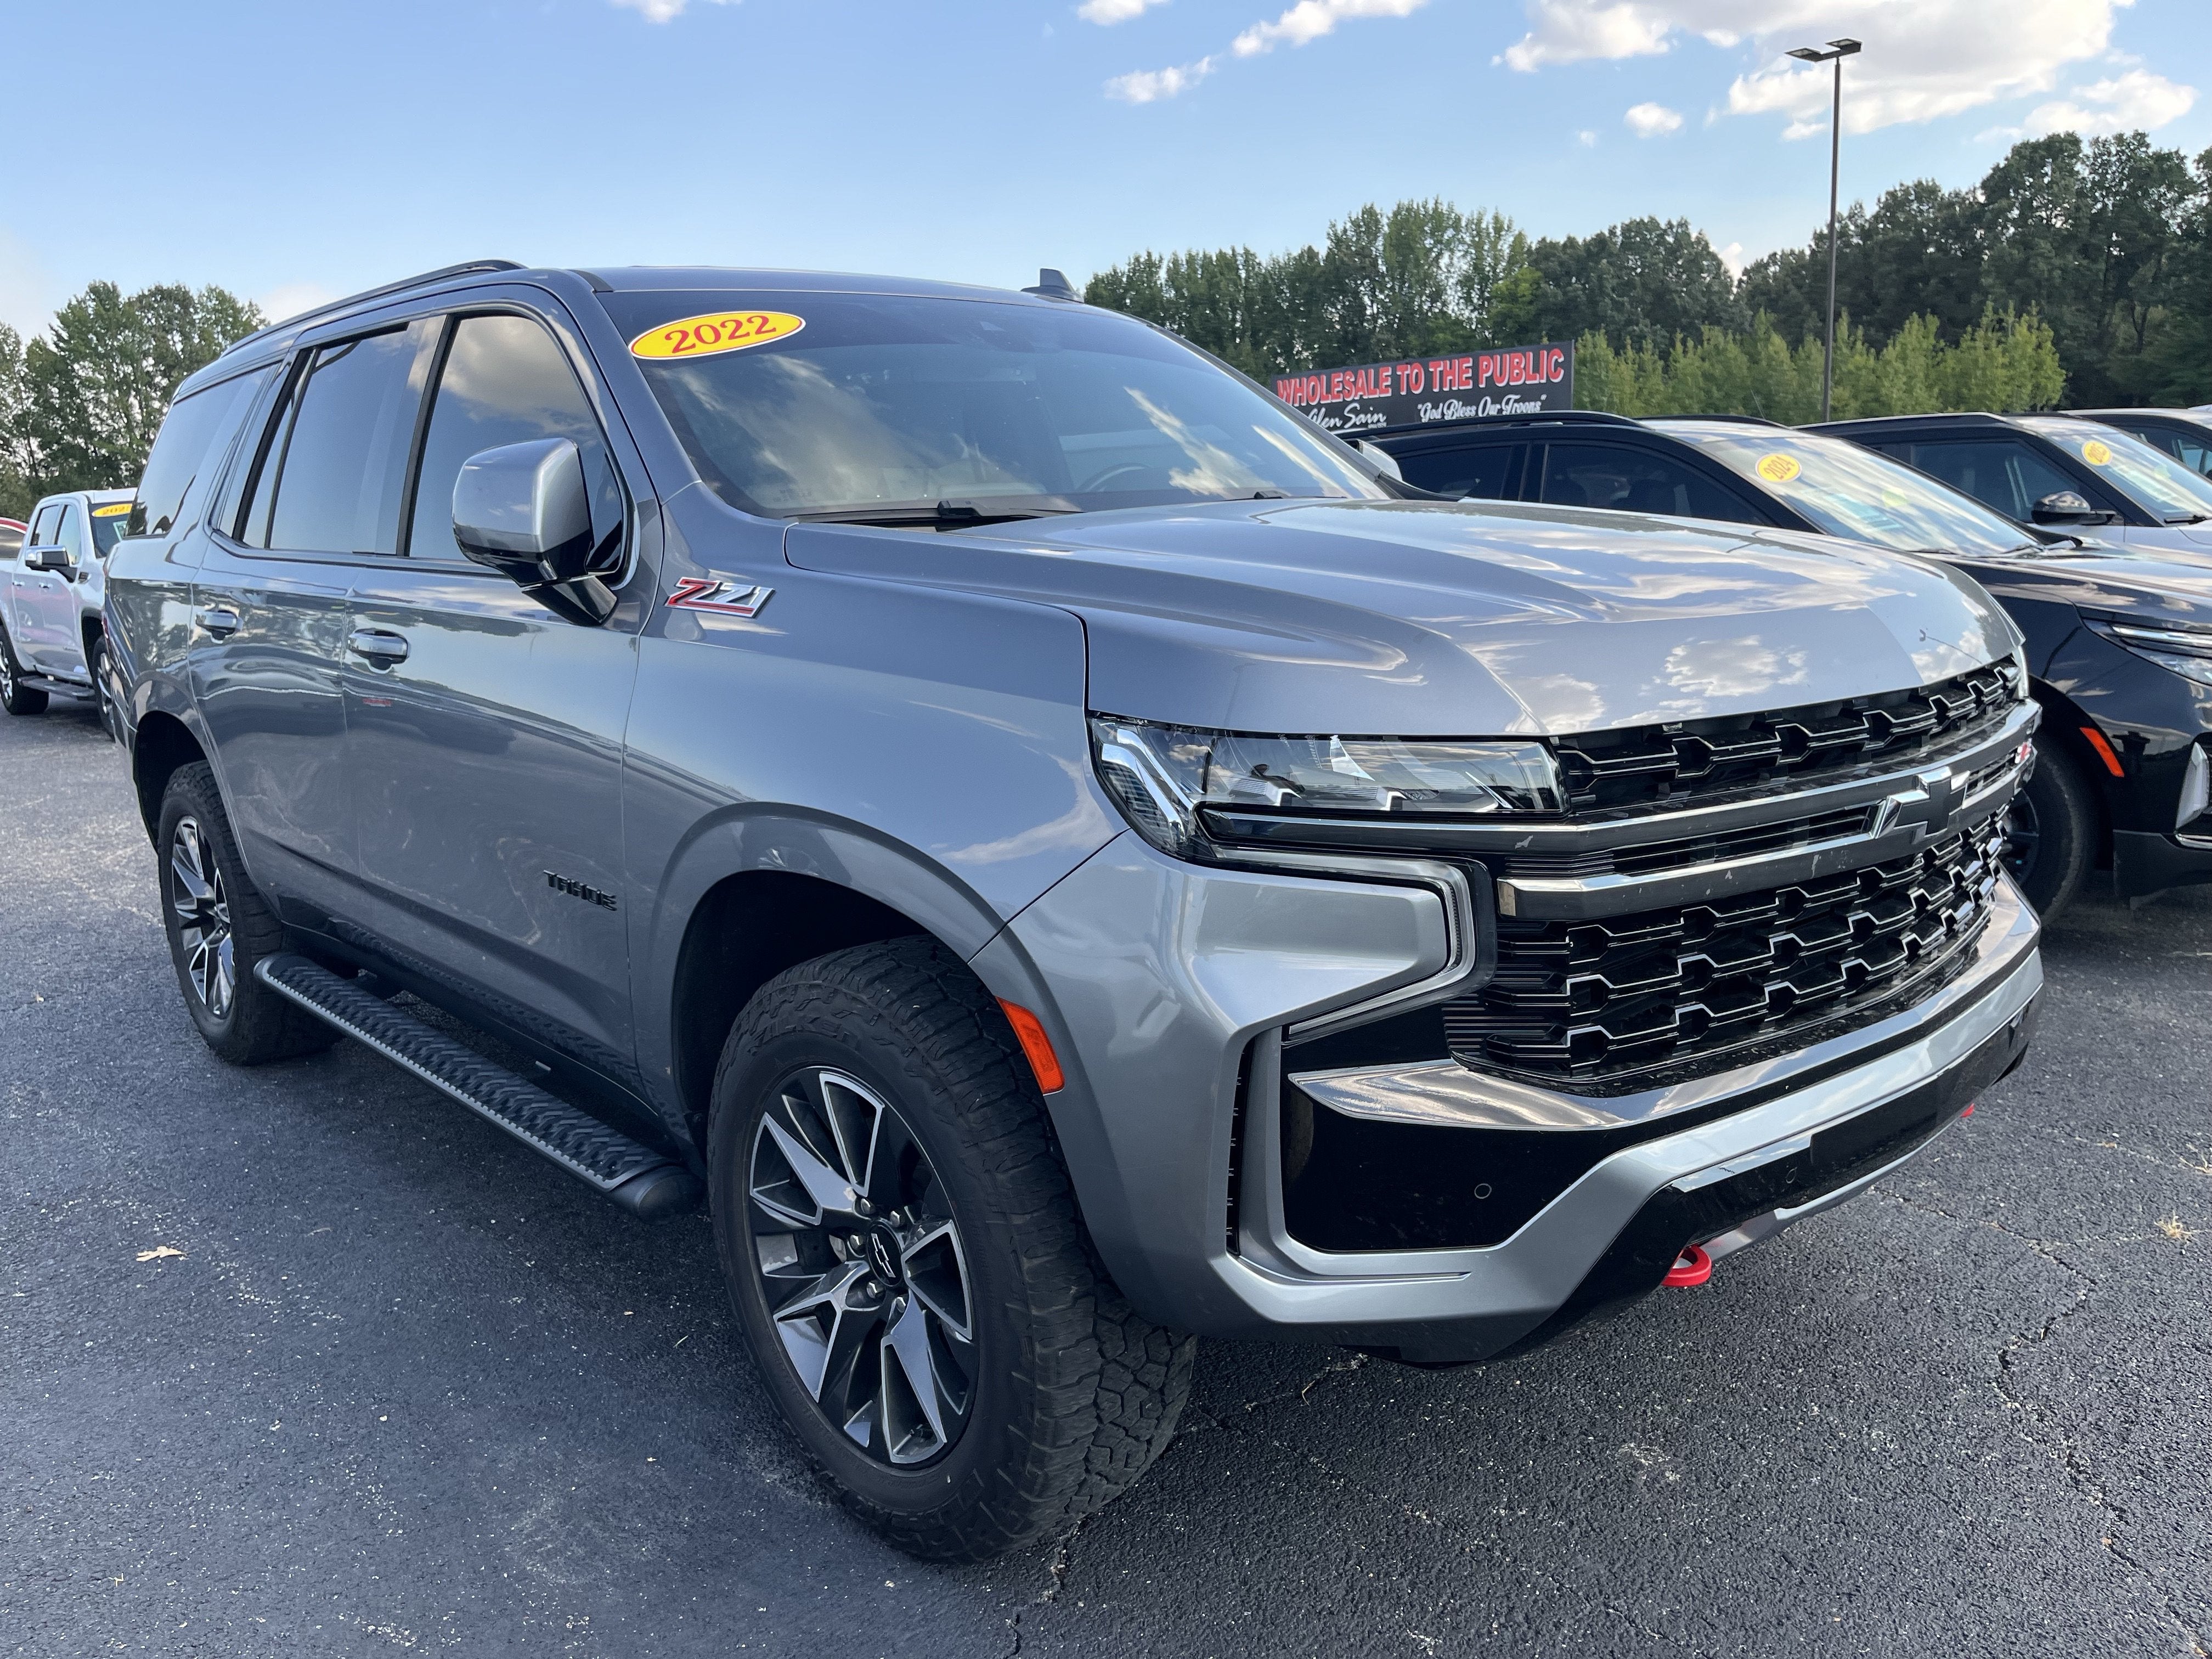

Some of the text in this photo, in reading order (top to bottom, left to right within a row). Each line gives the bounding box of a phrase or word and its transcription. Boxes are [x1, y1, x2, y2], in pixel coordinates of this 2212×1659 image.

[664, 315, 776, 354] 2022
[1277, 348, 1565, 407] WHOLESALE TO THE PUBLIC
[1344, 403, 1387, 429] Sain
[1443, 399, 1477, 420] Bless
[1477, 396, 1501, 417] Our
[664, 577, 776, 619] Z71
[543, 869, 617, 911] TAHOE
